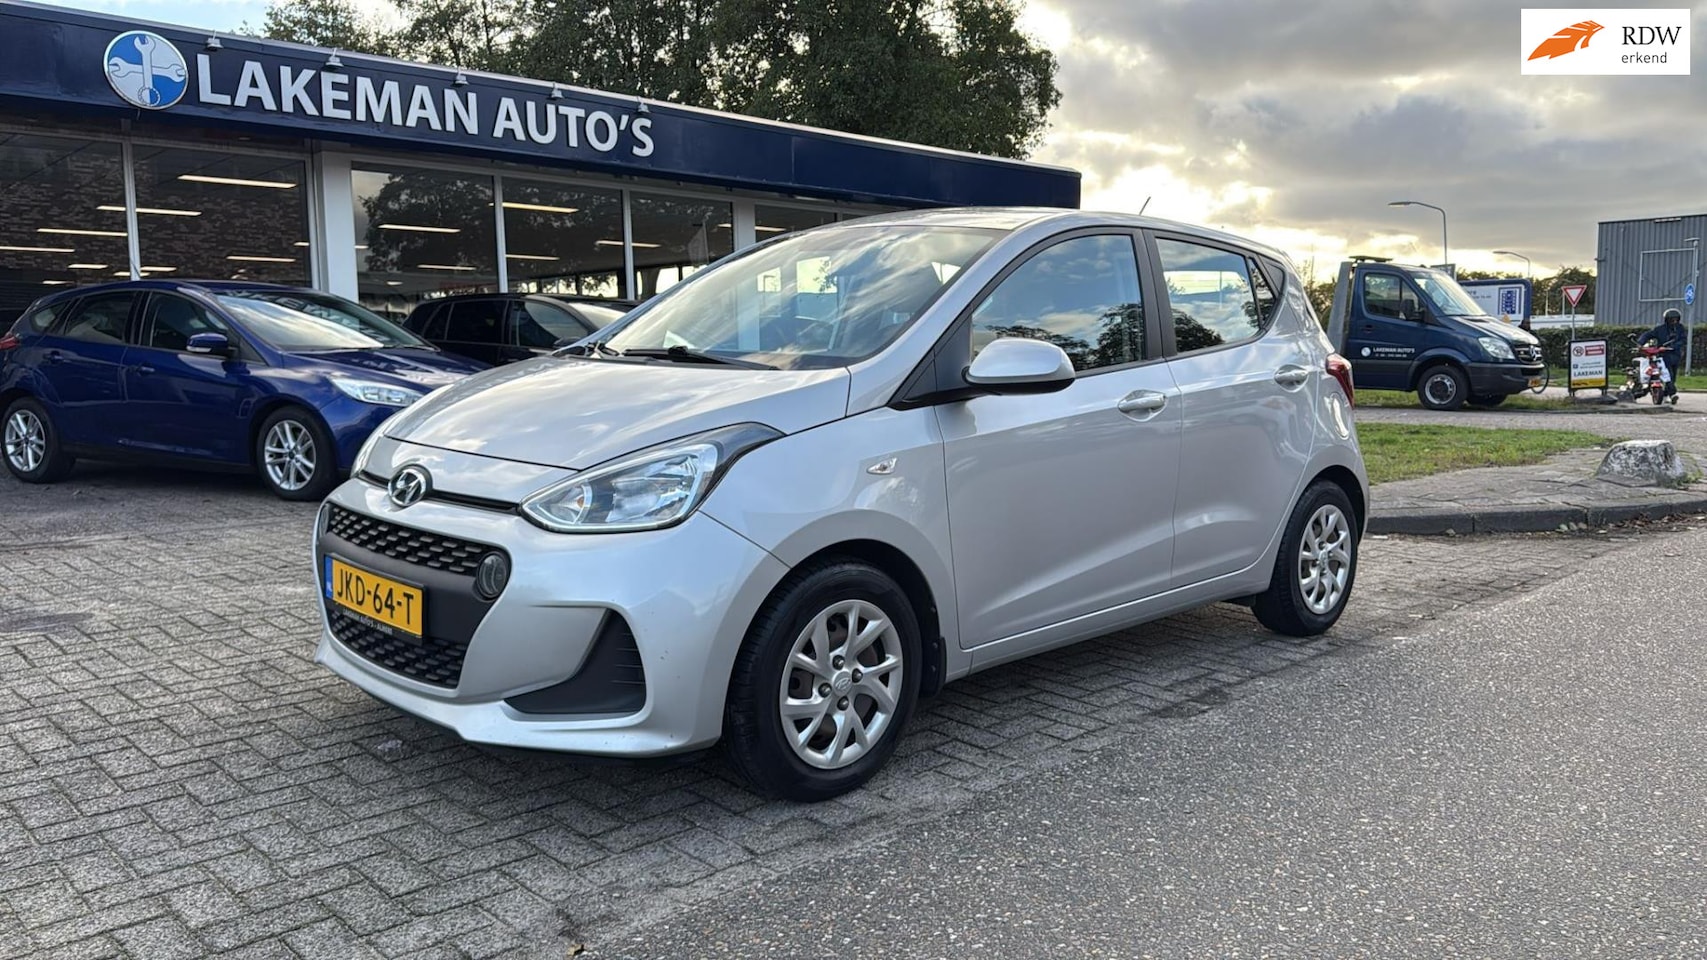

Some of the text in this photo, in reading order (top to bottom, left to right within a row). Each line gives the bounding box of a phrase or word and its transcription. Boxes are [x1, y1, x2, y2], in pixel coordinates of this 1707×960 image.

[196, 53, 655, 157] LAKEMAN AUTO'S
[337, 568, 414, 625] JKD-64-T
